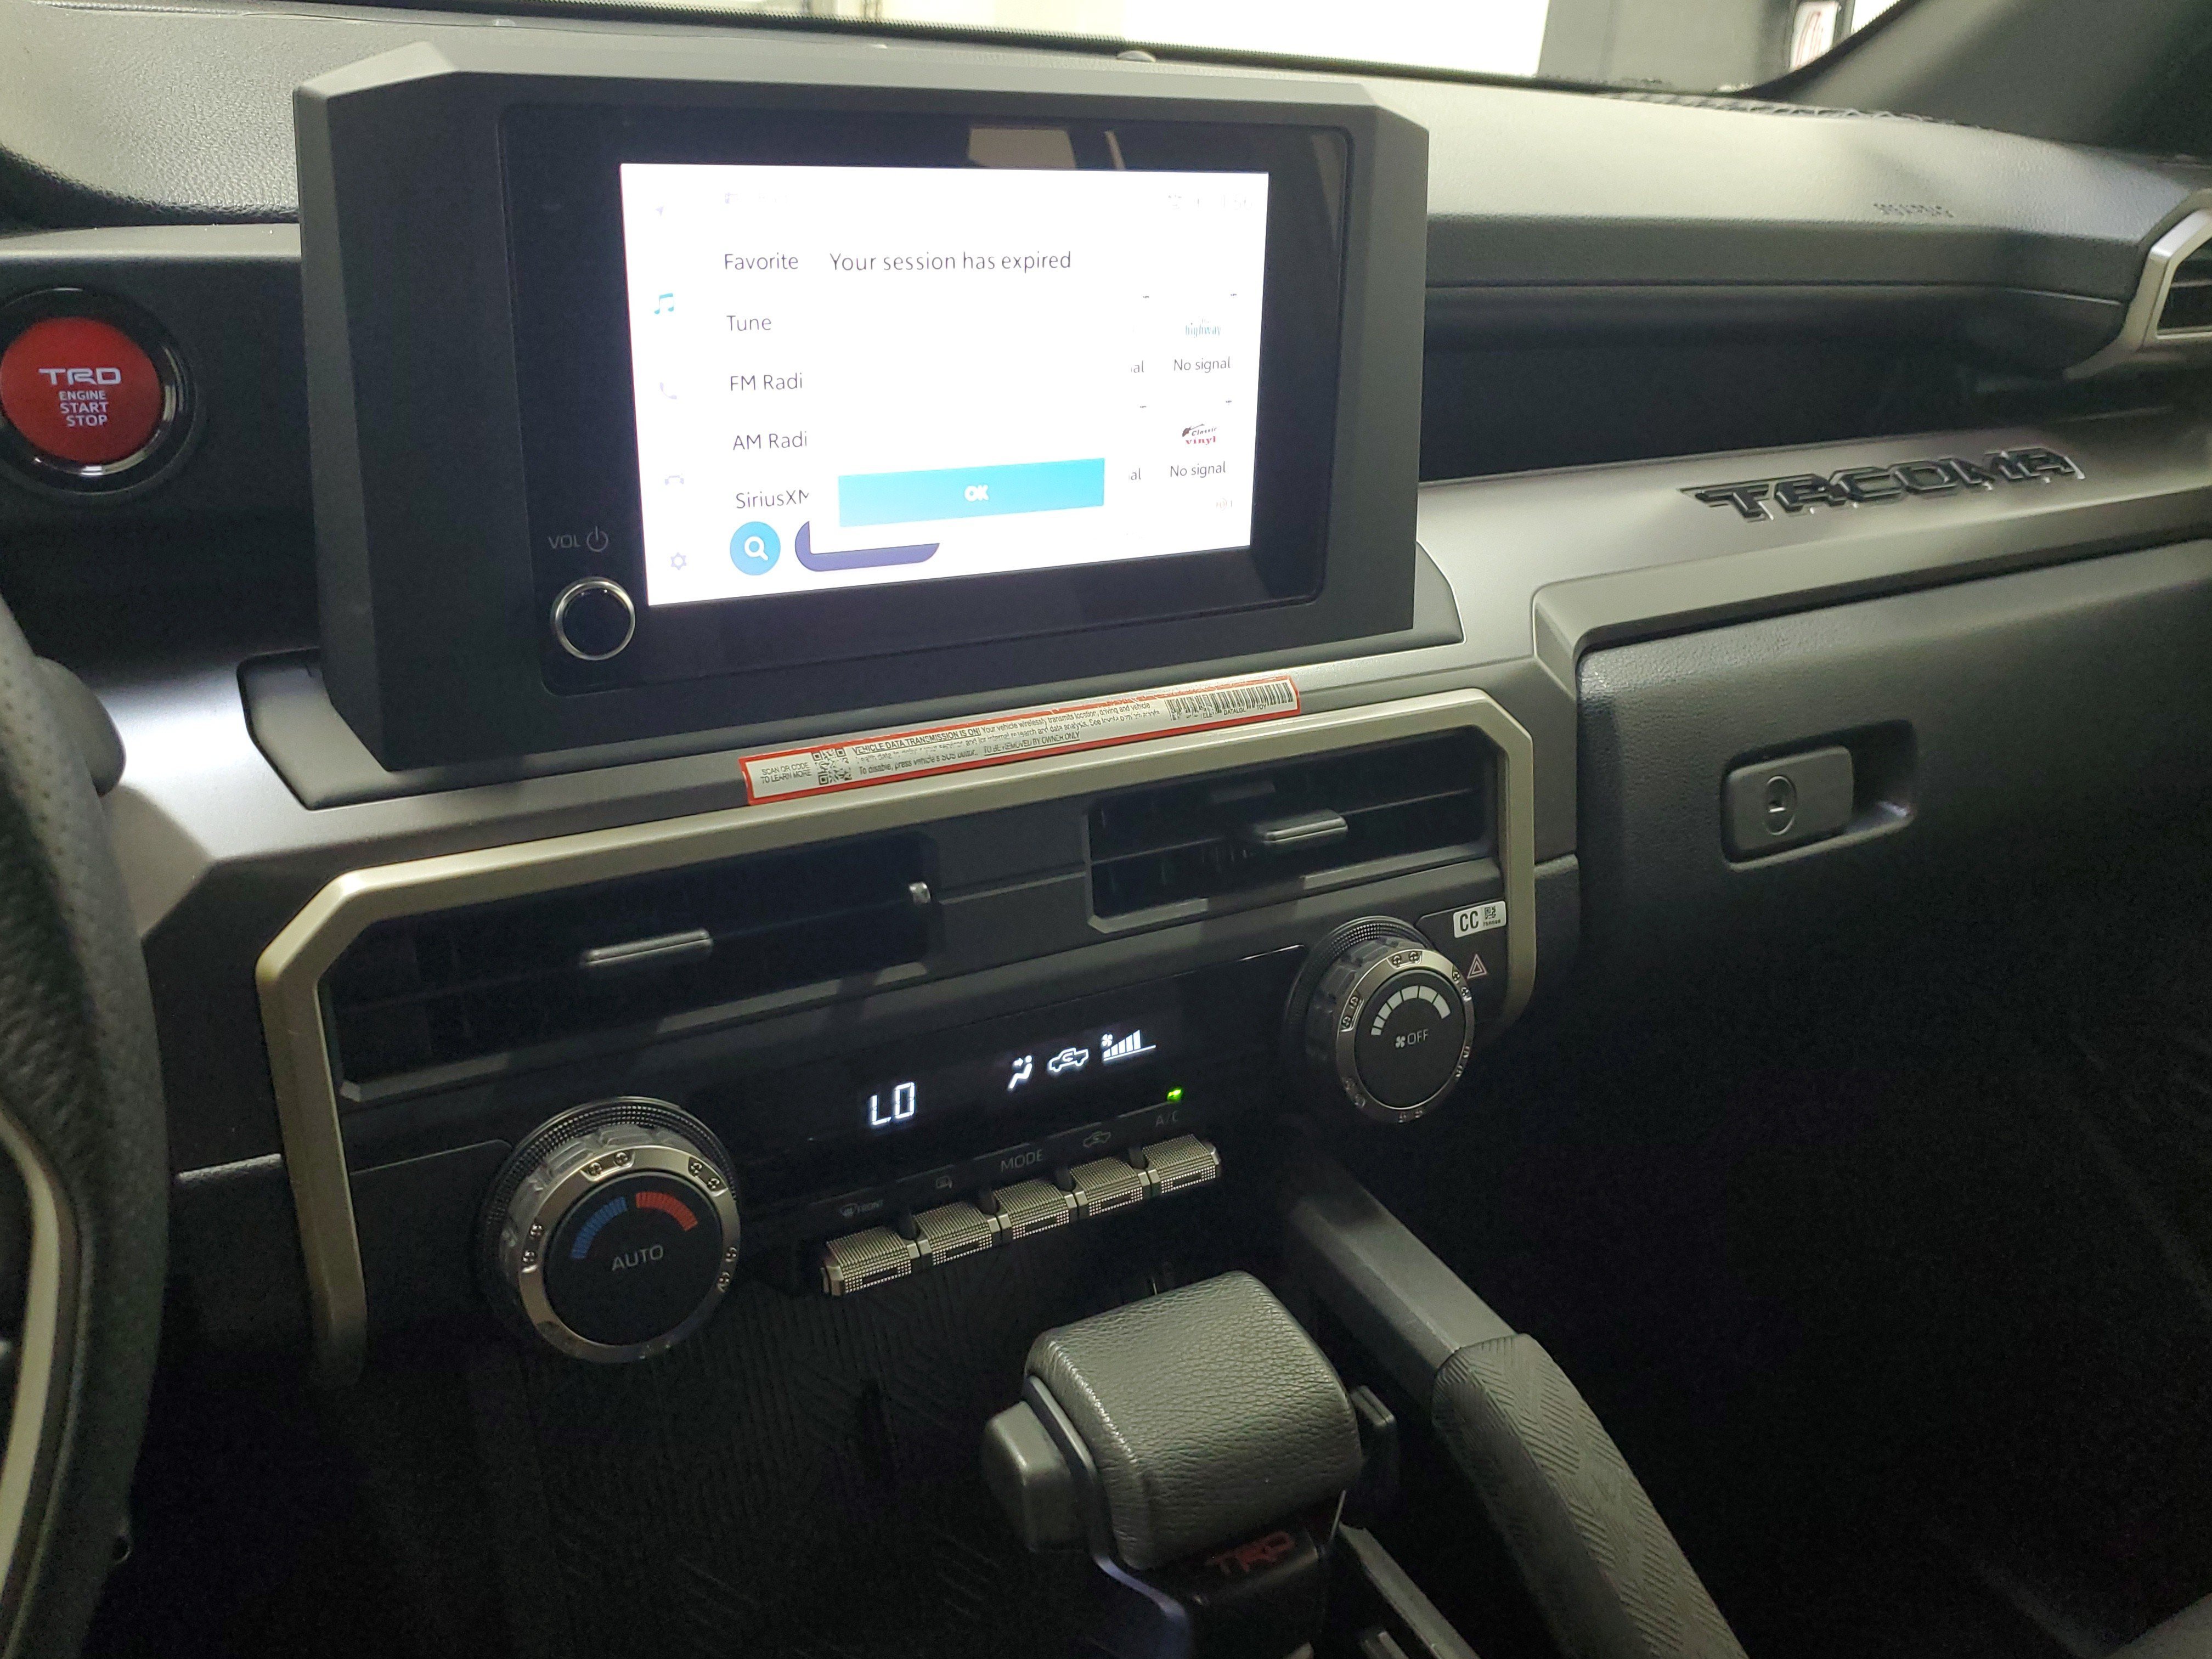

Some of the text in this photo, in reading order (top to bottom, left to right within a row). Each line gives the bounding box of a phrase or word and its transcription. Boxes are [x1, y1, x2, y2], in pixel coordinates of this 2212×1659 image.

[725, 252, 799, 270] Favorite
[830, 251, 1071, 274] Your session has expired
[726, 315, 771, 331] Tune
[1173, 358, 1192, 371] No
[1195, 356, 1231, 373] signal
[38, 368, 122, 386] TRD
[730, 375, 756, 391] FM
[58, 390, 107, 401] ENGINE
[60, 401, 109, 414] START
[66, 415, 108, 427] STOP
[733, 434, 761, 450] AM
[1185, 436, 1216, 445] vinyl
[1170, 465, 1188, 477] No
[1191, 461, 1226, 478] signal
[1677, 446, 2086, 522] TACOMA
[964, 484, 990, 502] OK
[548, 534, 581, 549] VOL
[852, 742, 884, 754] VEHICLE
[885, 740, 905, 749] DATA
[906, 731, 959, 746] TRANSMISSION
[1048, 714, 1074, 723] transmits
[1119, 704, 1130, 713] and
[761, 766, 780, 775] SCAN
[791, 762, 810, 770] CODE
[1460, 911, 1479, 932] CC
[1407, 1029, 1429, 1045] OFF
[1155, 1110, 1179, 1126] A/C
[1000, 1149, 1042, 1172] MODE
[611, 1244, 664, 1272] AUTO
